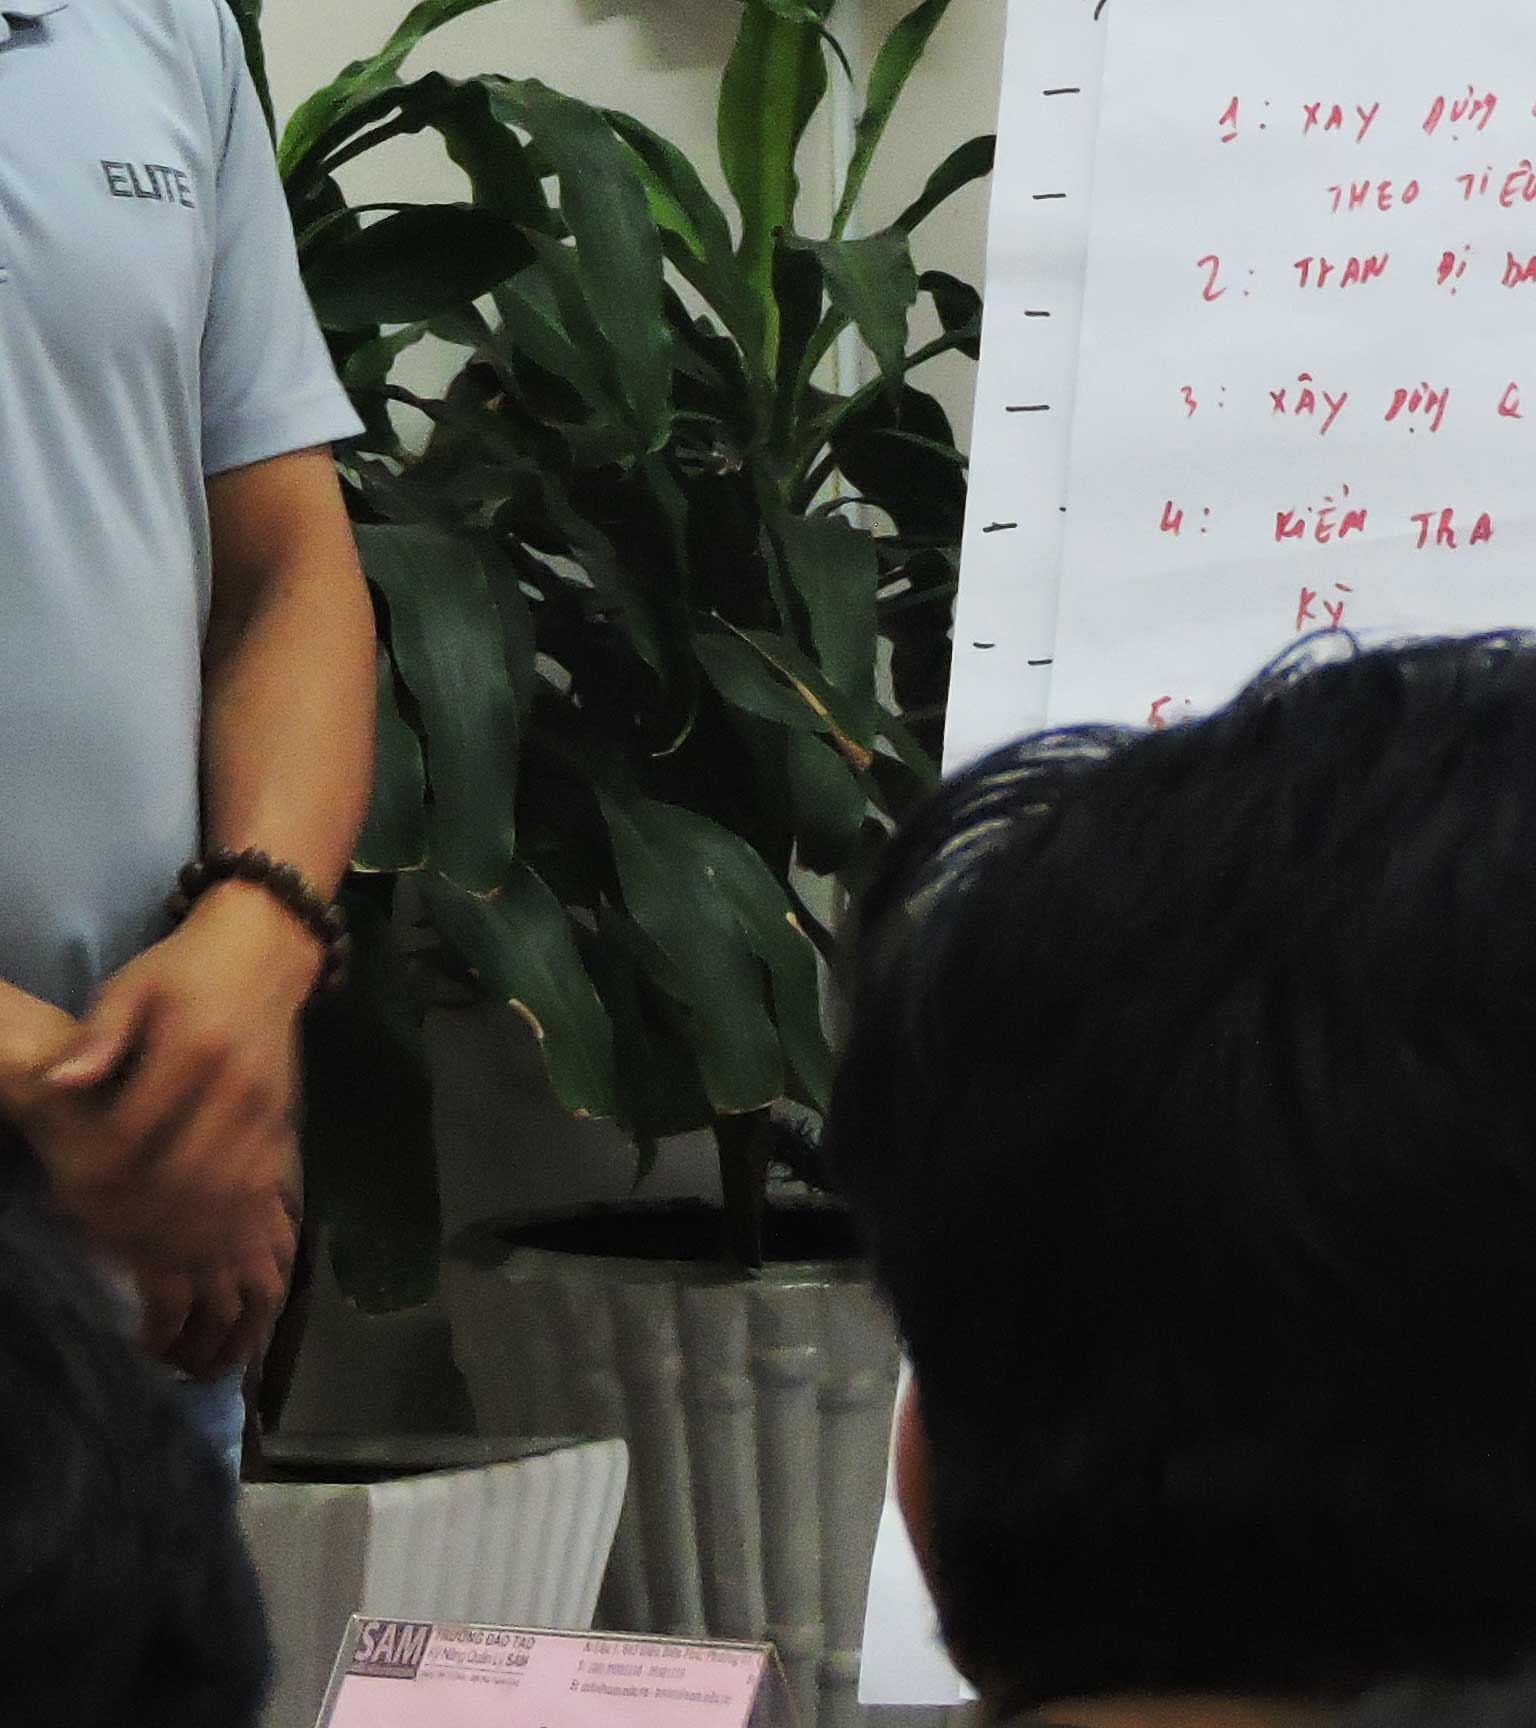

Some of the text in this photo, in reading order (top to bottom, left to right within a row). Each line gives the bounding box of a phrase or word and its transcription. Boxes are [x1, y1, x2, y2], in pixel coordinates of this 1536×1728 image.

[100, 159, 196, 210] ELITE
[1326, 179, 1420, 214] THEO
[353, 1622, 429, 1668] SAM
